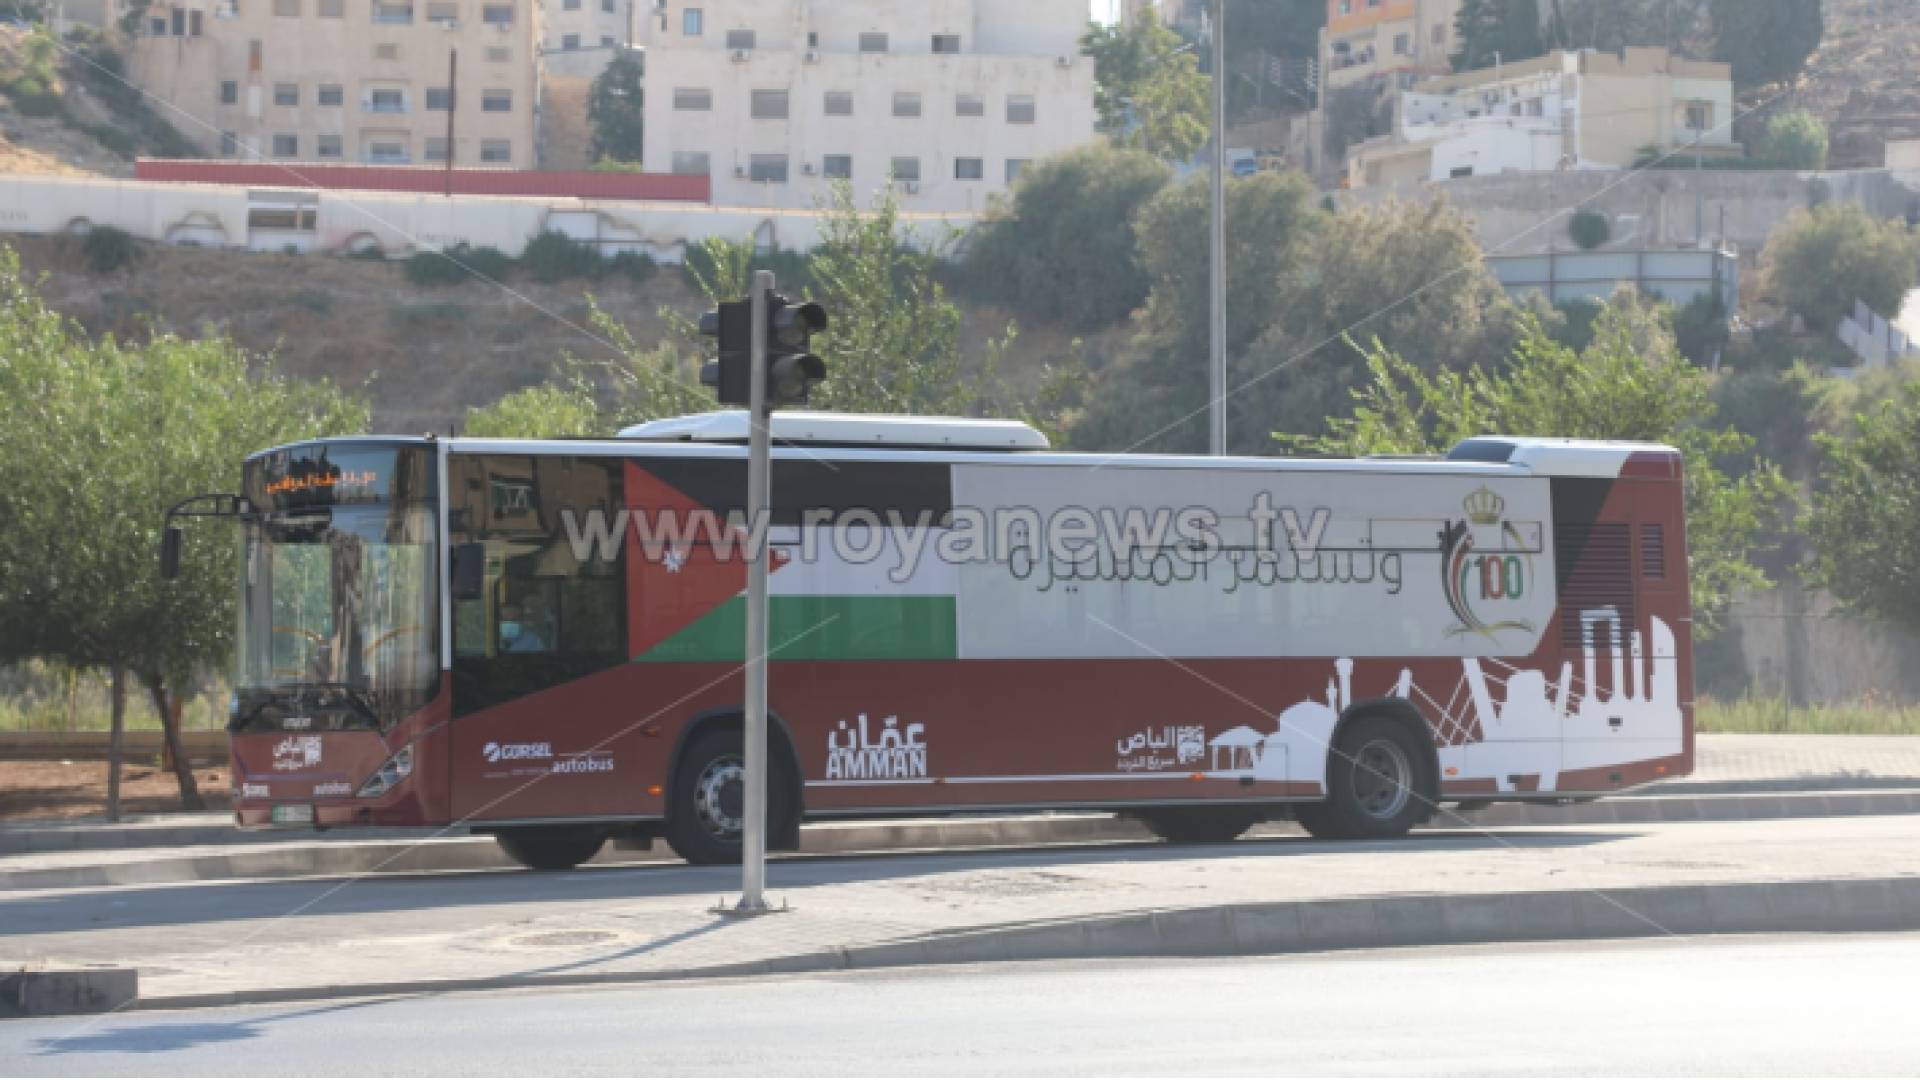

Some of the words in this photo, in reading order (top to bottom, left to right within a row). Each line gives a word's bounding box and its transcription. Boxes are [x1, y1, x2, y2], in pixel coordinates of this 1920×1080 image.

[1473, 555, 1524, 600] 100
[551, 756, 614, 773] autobus
[826, 748, 928, 779] AMMAN
